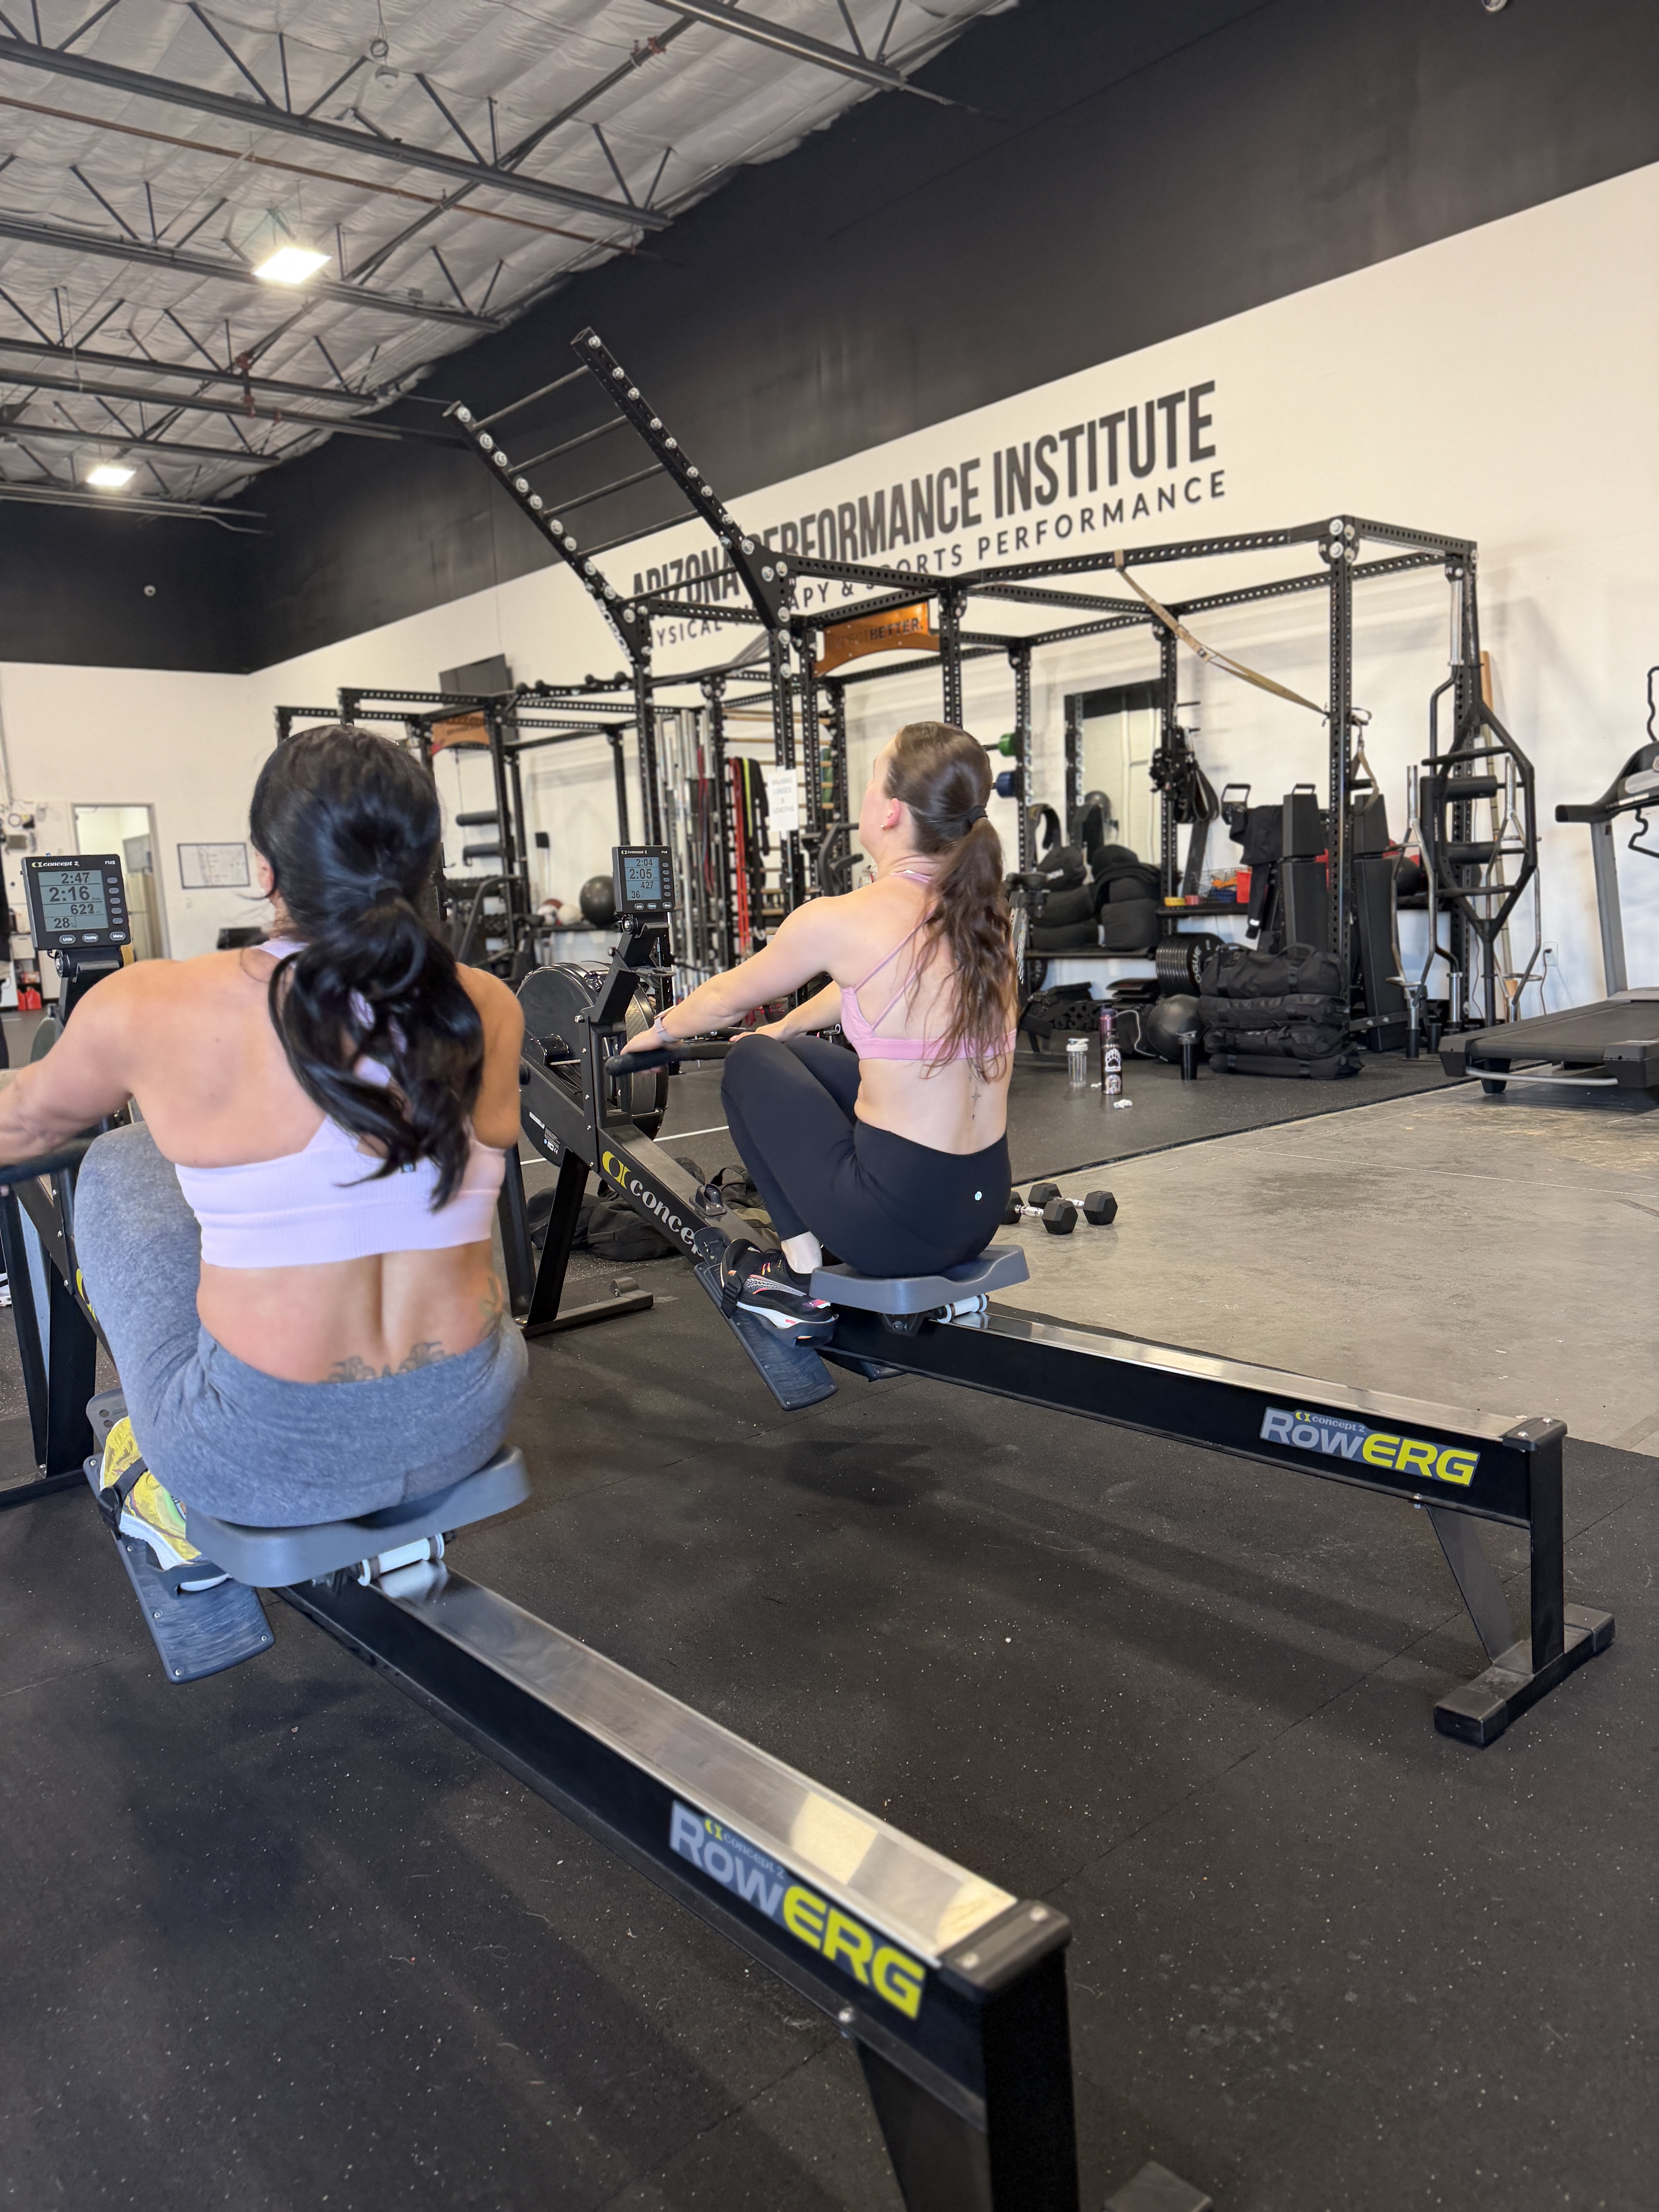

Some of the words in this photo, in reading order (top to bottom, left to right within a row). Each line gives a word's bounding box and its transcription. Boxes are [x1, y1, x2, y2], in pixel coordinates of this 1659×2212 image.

[747, 458, 981, 562] RFORMANCE
[994, 380, 1216, 519] INSTITUTE
[656, 620, 722, 646] YSICAL
[866, 543, 963, 590] ORTS
[978, 469, 1225, 560] PERFORMANCE
[61, 872, 89, 884] 2:47
[629, 869, 652, 879] 2:05
[49, 886, 90, 902] 2:16
[54, 917, 70, 929] 28
[1193, 946, 1201, 983] OGUE
[630, 1180, 703, 1257] conce
[1312, 1416, 1357, 1432] concept
[723, 1831, 775, 1873] concept
